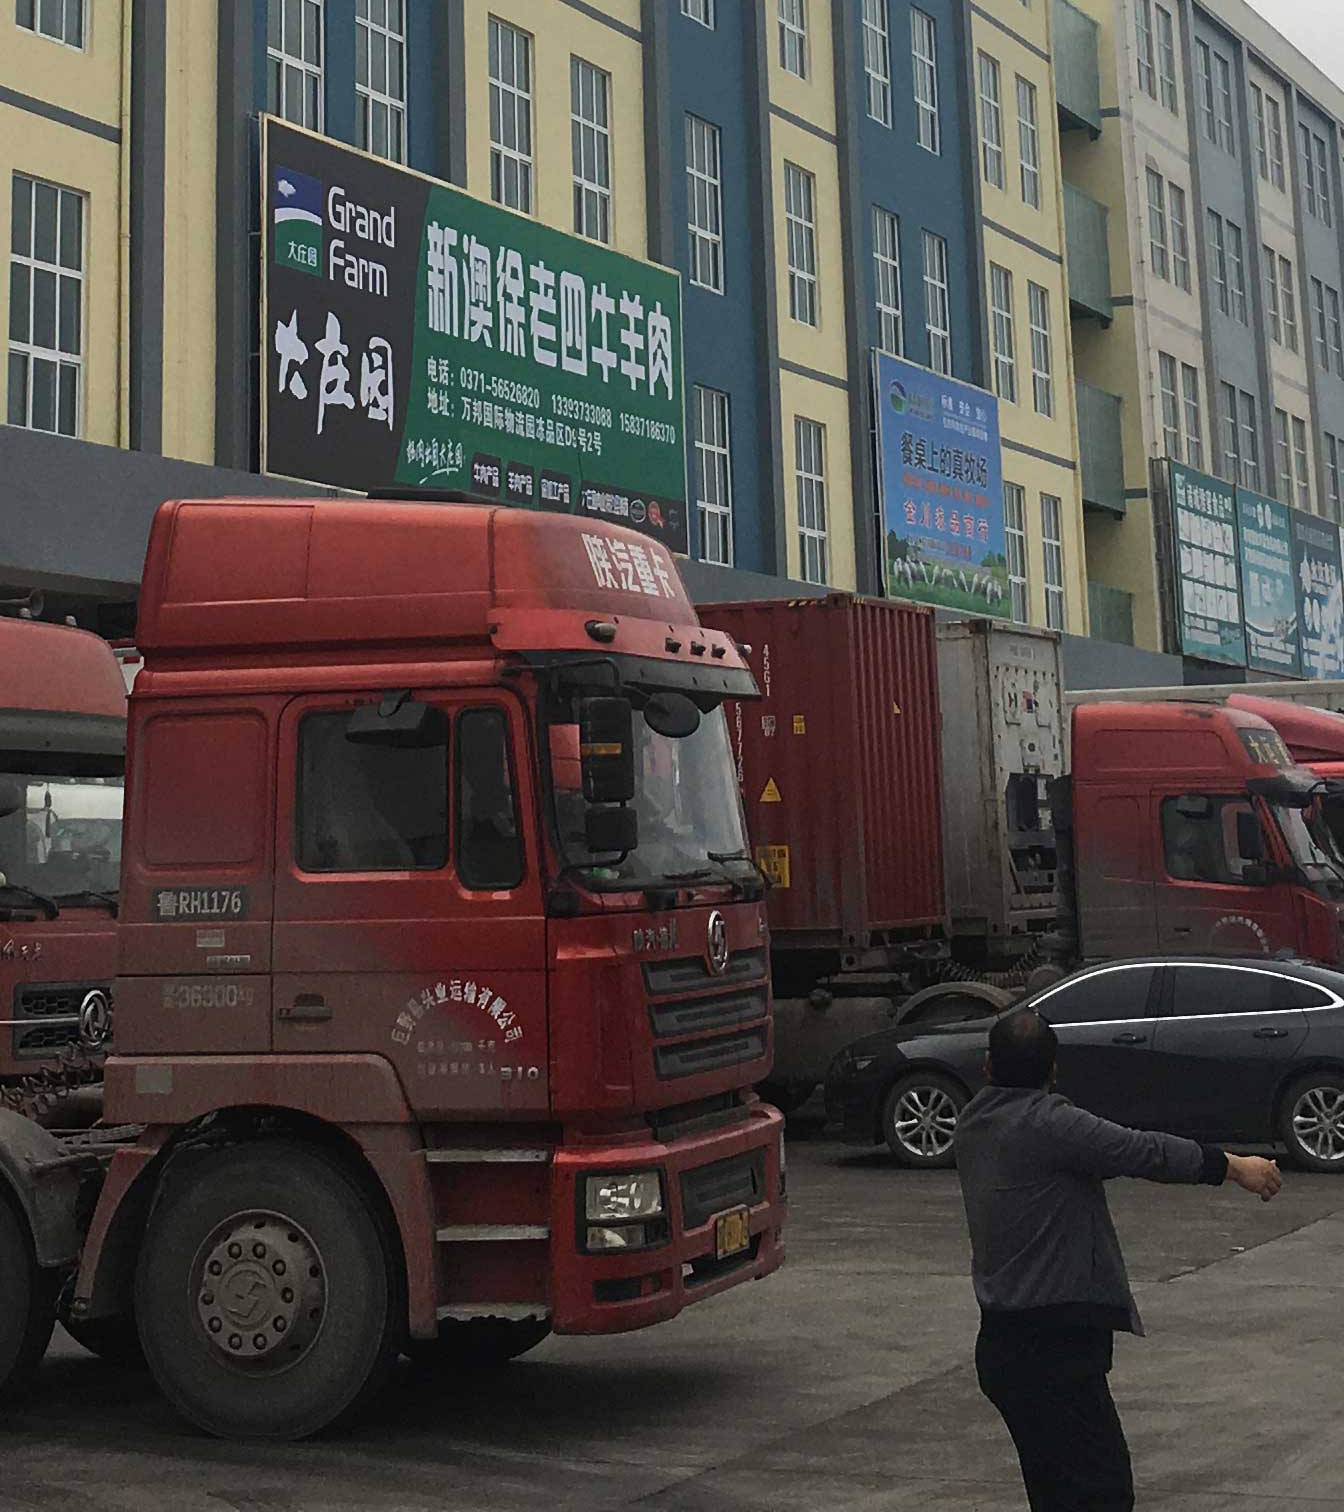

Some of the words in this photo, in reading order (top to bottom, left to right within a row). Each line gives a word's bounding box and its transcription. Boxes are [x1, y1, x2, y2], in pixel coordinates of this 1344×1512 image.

[327, 185, 396, 249] Grand
[287, 240, 318, 268] 大庄园
[328, 238, 389, 297] Farm
[426, 219, 675, 402] 新澳徐老四牛羊肉
[274, 308, 397, 435] 大庄园
[899, 429, 989, 489] 餐桌上的真牧场
[580, 532, 677, 600] 陕汽重卡
[157, 890, 242, 916] 鲁RH1176
